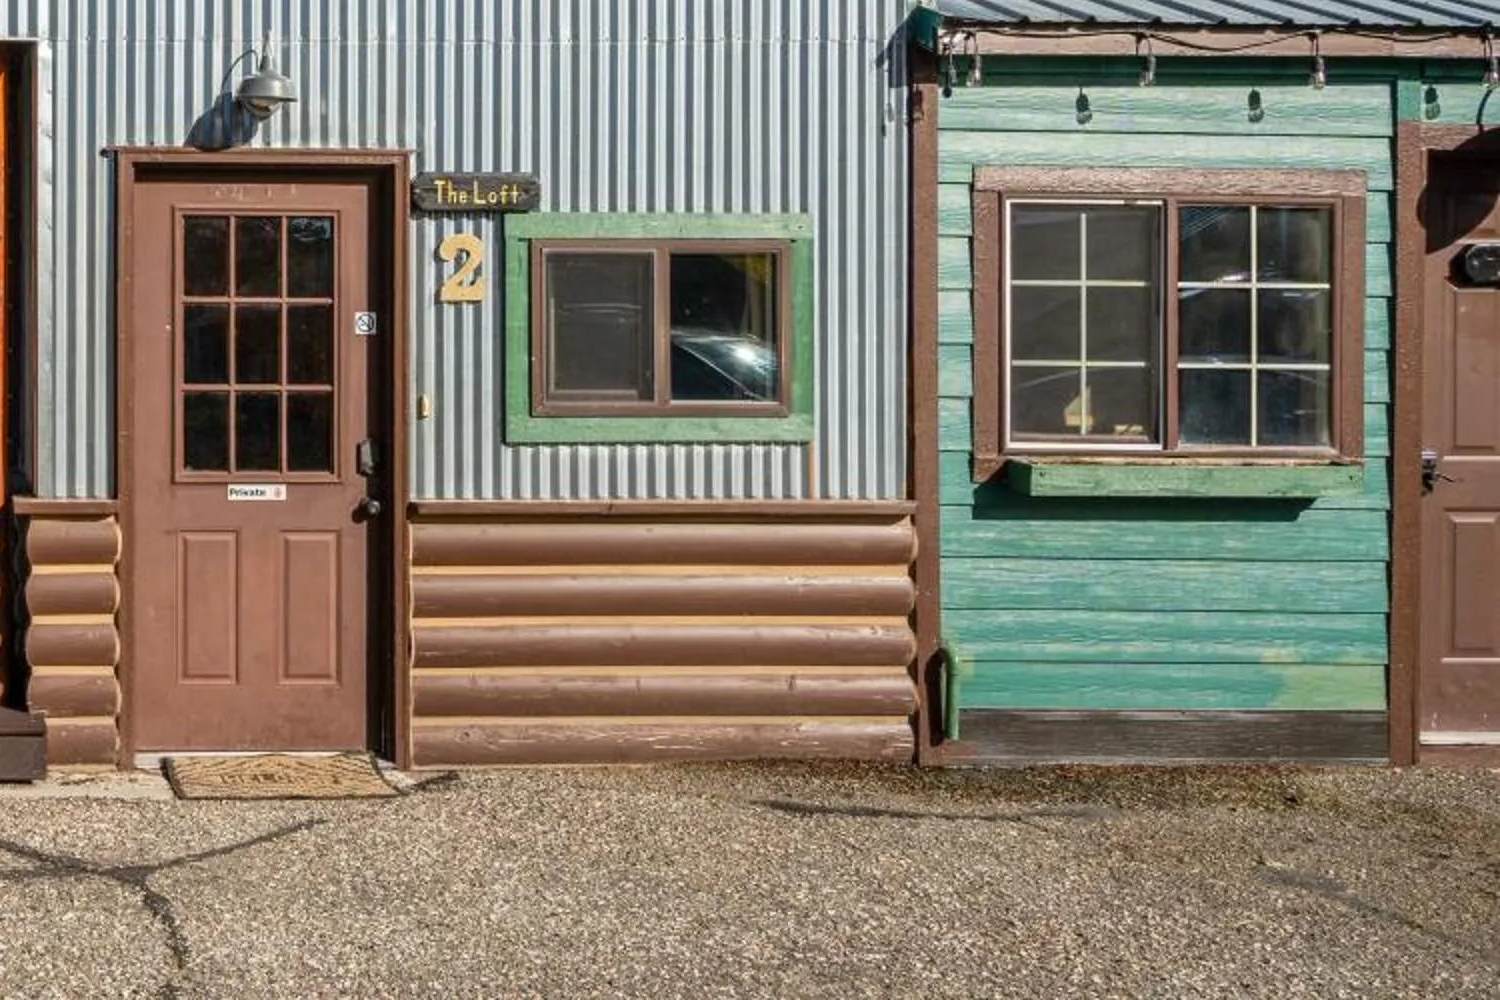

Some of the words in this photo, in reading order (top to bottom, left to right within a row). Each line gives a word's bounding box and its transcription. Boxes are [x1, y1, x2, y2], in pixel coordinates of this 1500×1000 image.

[433, 178, 468, 205] The
[473, 177, 519, 206] Loft
[438, 232, 485, 302] 2
[229, 487, 268, 498] Private
